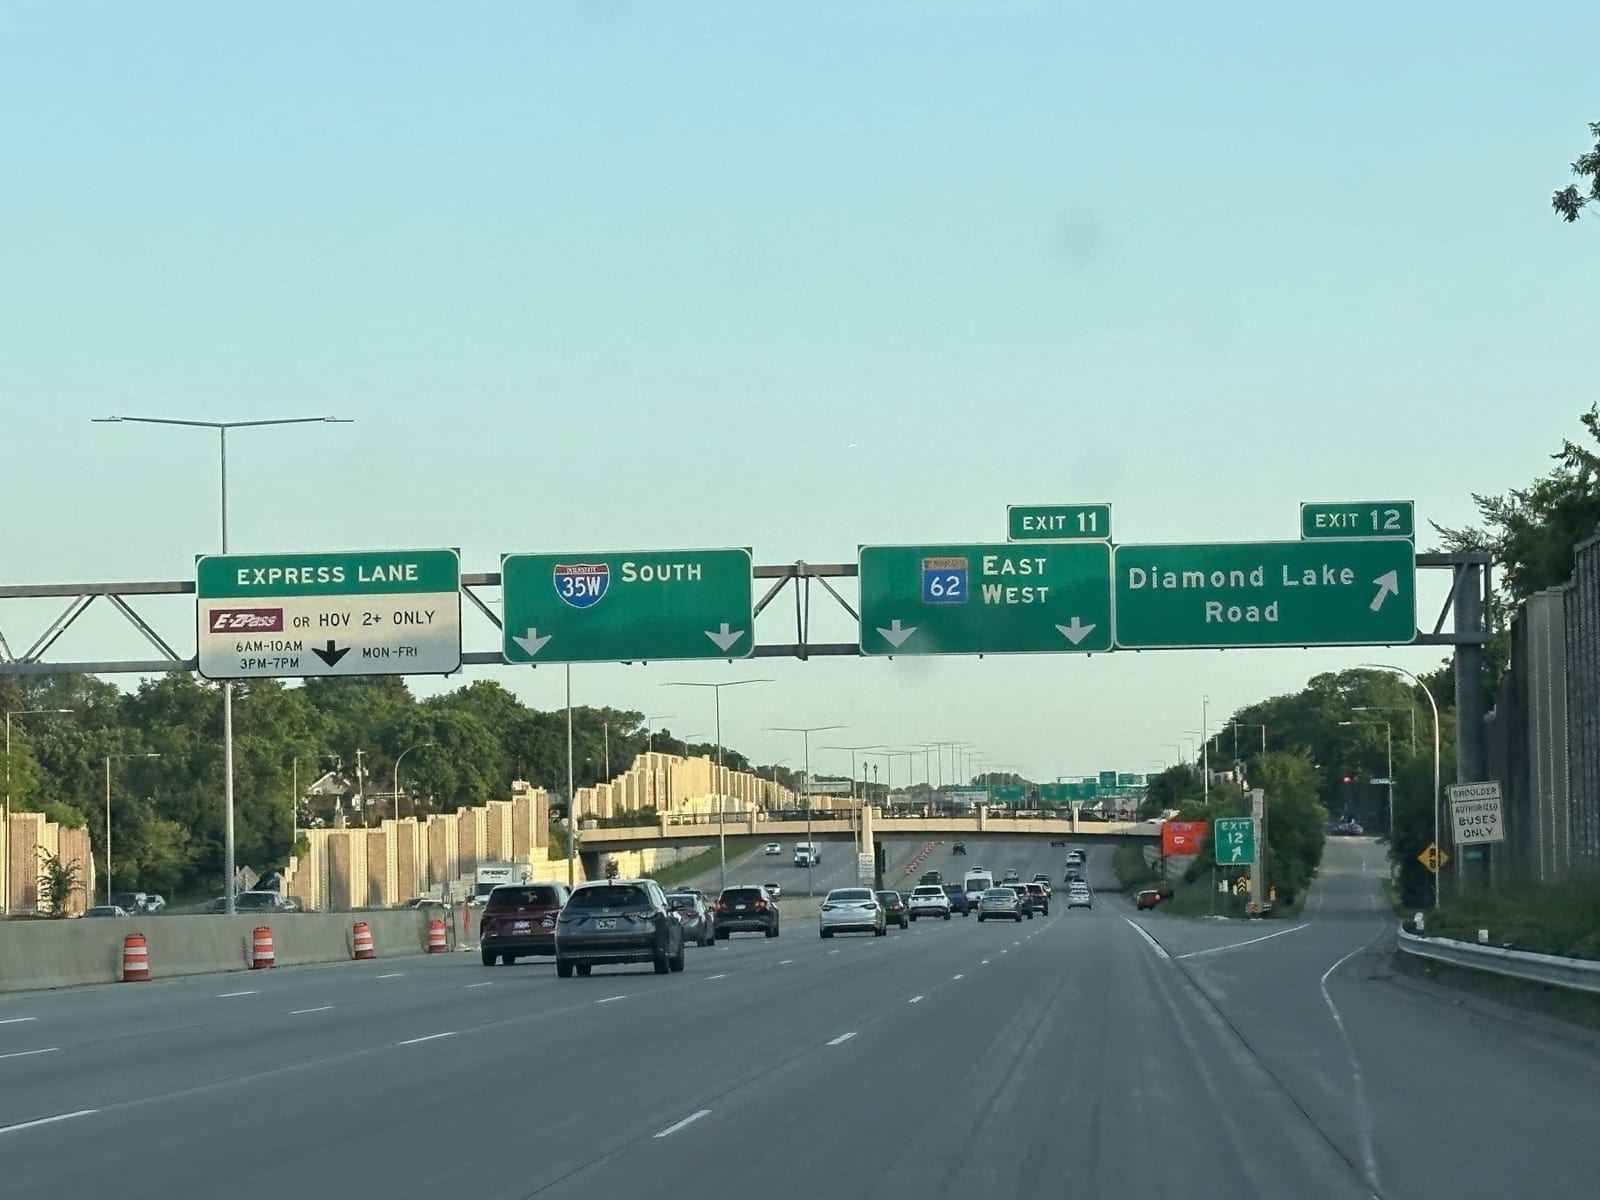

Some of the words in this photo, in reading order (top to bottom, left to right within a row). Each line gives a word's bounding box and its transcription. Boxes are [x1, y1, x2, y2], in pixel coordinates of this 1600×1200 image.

[1022, 515, 1066, 530] EXIT
[1077, 512, 1097, 532] 11
[1315, 512, 1359, 528] EXIT
[1370, 509, 1400, 530] 12
[237, 566, 345, 585] EXPRESS
[358, 564, 418, 582] LANE
[1129, 565, 1263, 589] Diamond
[1283, 563, 1354, 587] Lake
[562, 576, 601, 597] 35W
[930, 575, 960, 597] 62
[1205, 601, 1279, 623] Road
[293, 617, 310, 628] OR
[319, 612, 350, 627] HOV
[362, 612, 382, 626] 2+
[393, 611, 435, 625] ONLY
[236, 640, 303, 652] 6AM-10AM
[362, 646, 418, 658] MON-FRI
[240, 657, 299, 669] 3PM-7PM
[1453, 786, 1497, 798] SHOULDER
[1221, 821, 1251, 831] EXIT
[1459, 814, 1497, 826] BUSES
[1228, 832, 1244, 844] 12
[1463, 827, 1493, 838] ONLY
